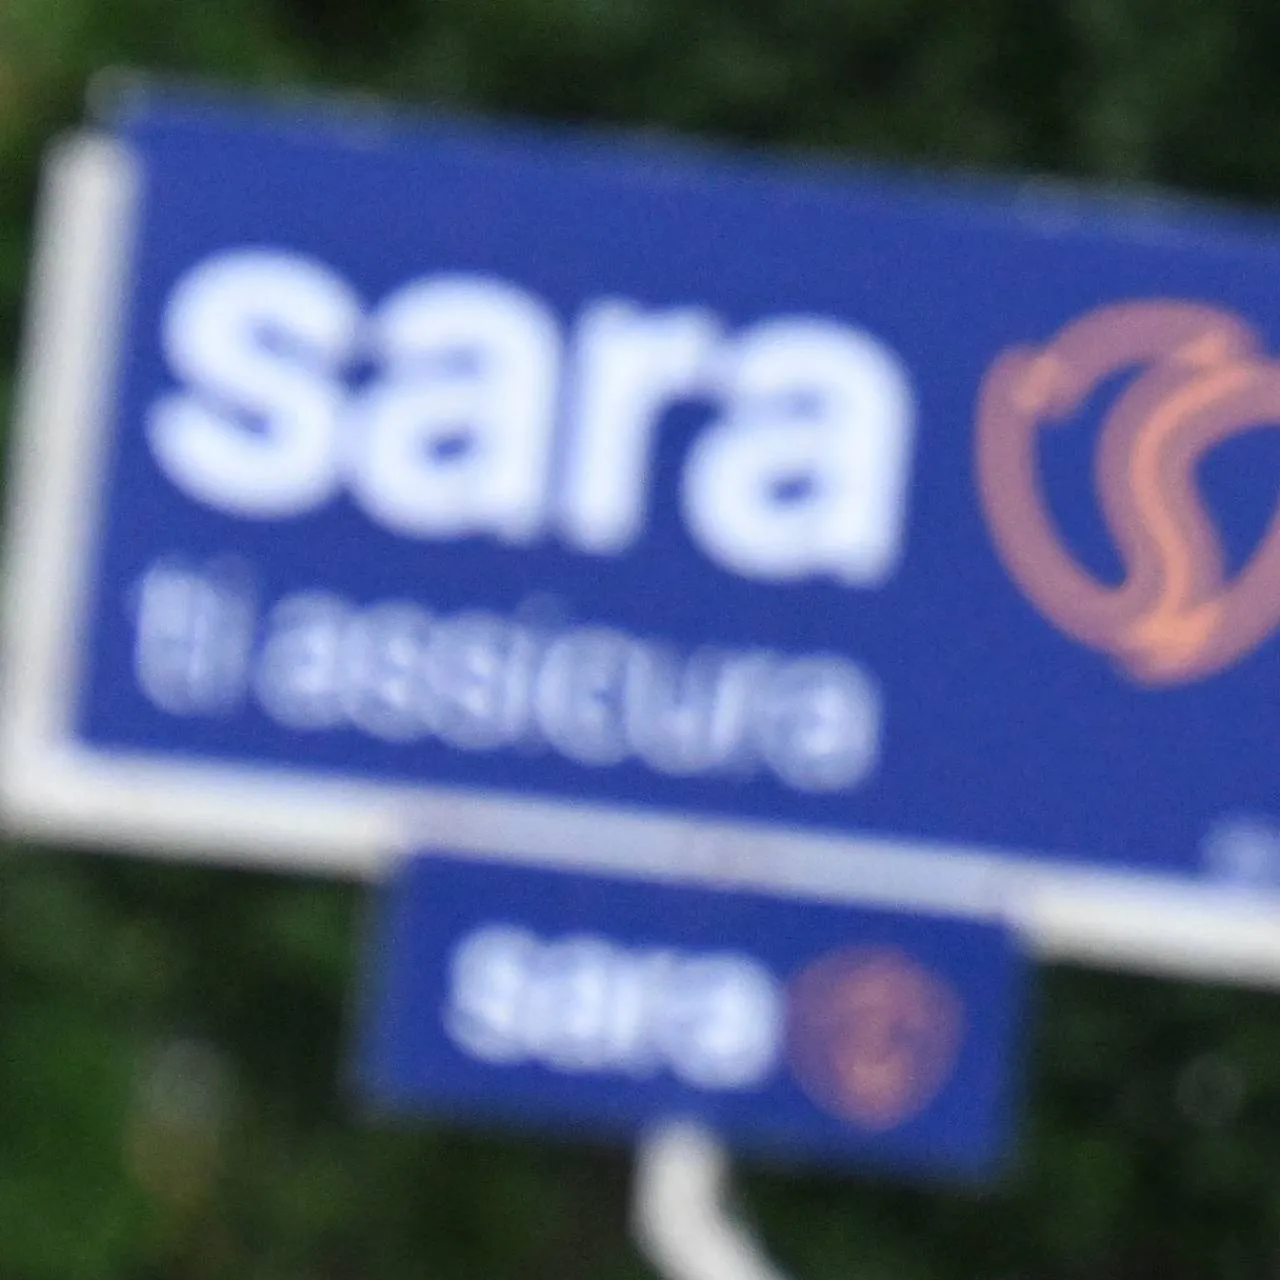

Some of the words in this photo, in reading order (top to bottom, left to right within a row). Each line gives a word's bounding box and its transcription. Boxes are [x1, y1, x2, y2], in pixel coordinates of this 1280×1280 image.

[146, 246, 916, 588] sara
[136, 558, 250, 716] ti
[255, 592, 880, 793] assicura
[448, 925, 783, 1090] sara
